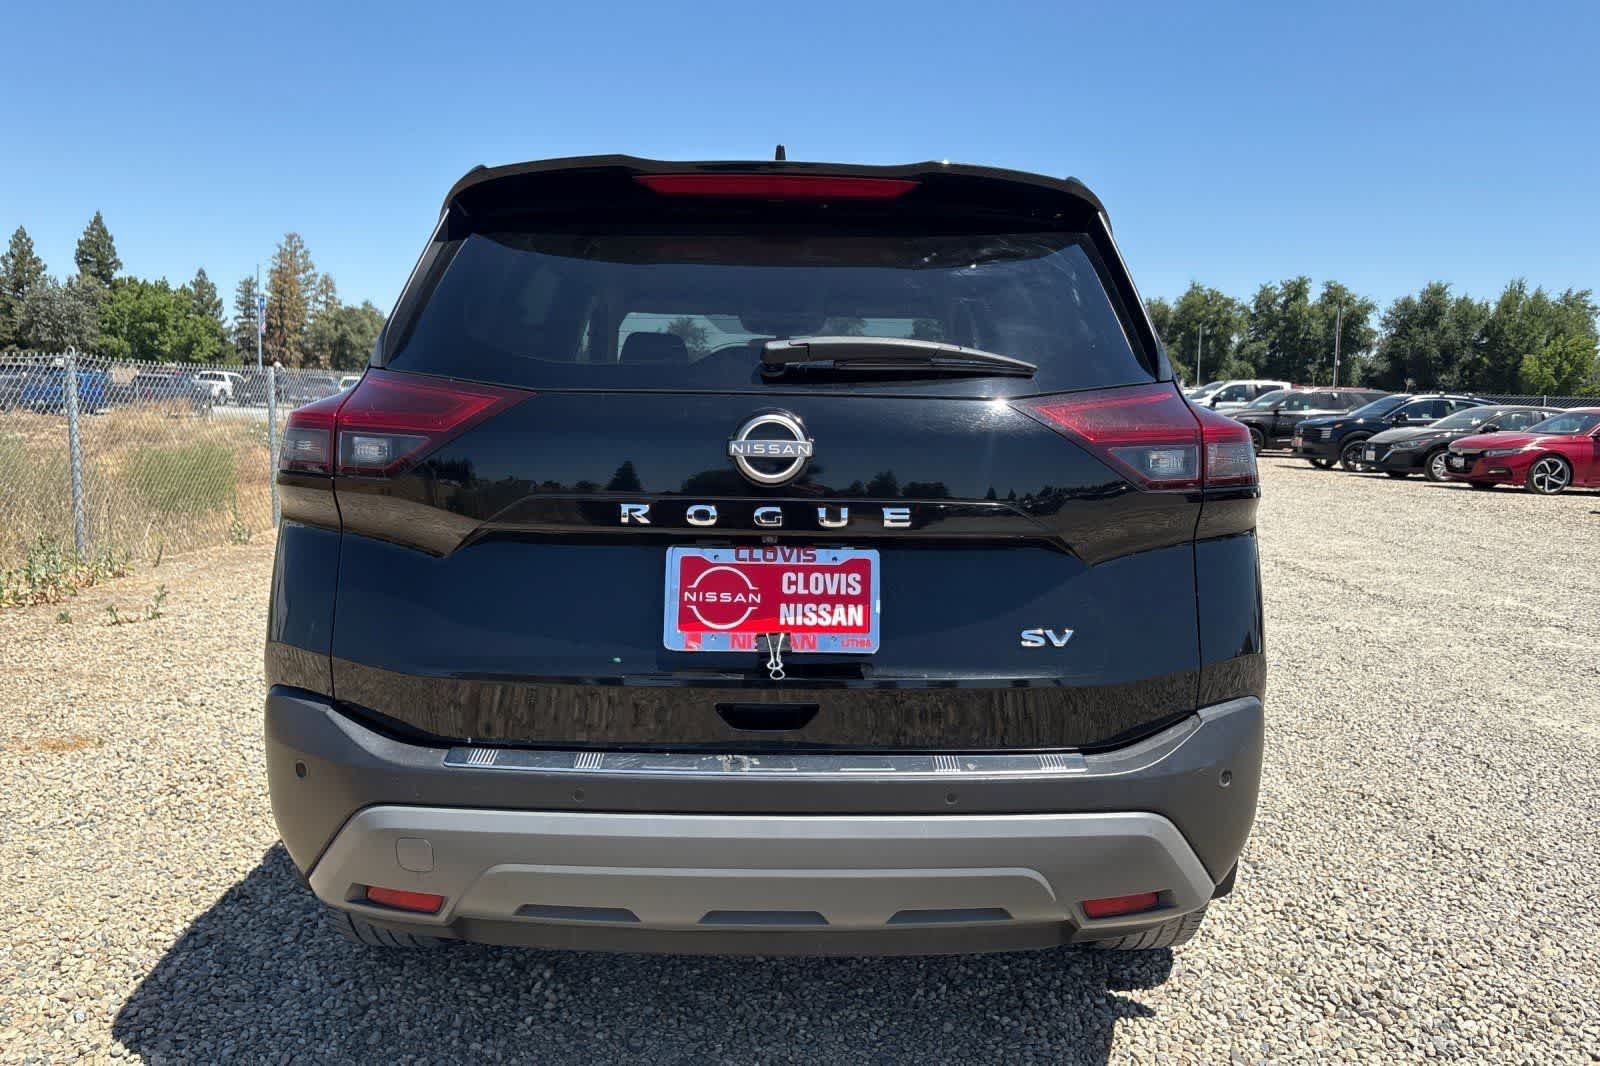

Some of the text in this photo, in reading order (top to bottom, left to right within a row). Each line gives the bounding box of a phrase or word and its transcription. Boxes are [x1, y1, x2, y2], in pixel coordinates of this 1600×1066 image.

[731, 443, 812, 455] NISSAN
[620, 503, 912, 528] ROGUE
[734, 546, 816, 563] CLOVIS
[781, 572, 862, 595] CLOVIS
[684, 591, 761, 604] NISSAN
[779, 603, 864, 627] NISSAN
[1020, 628, 1074, 647] SV
